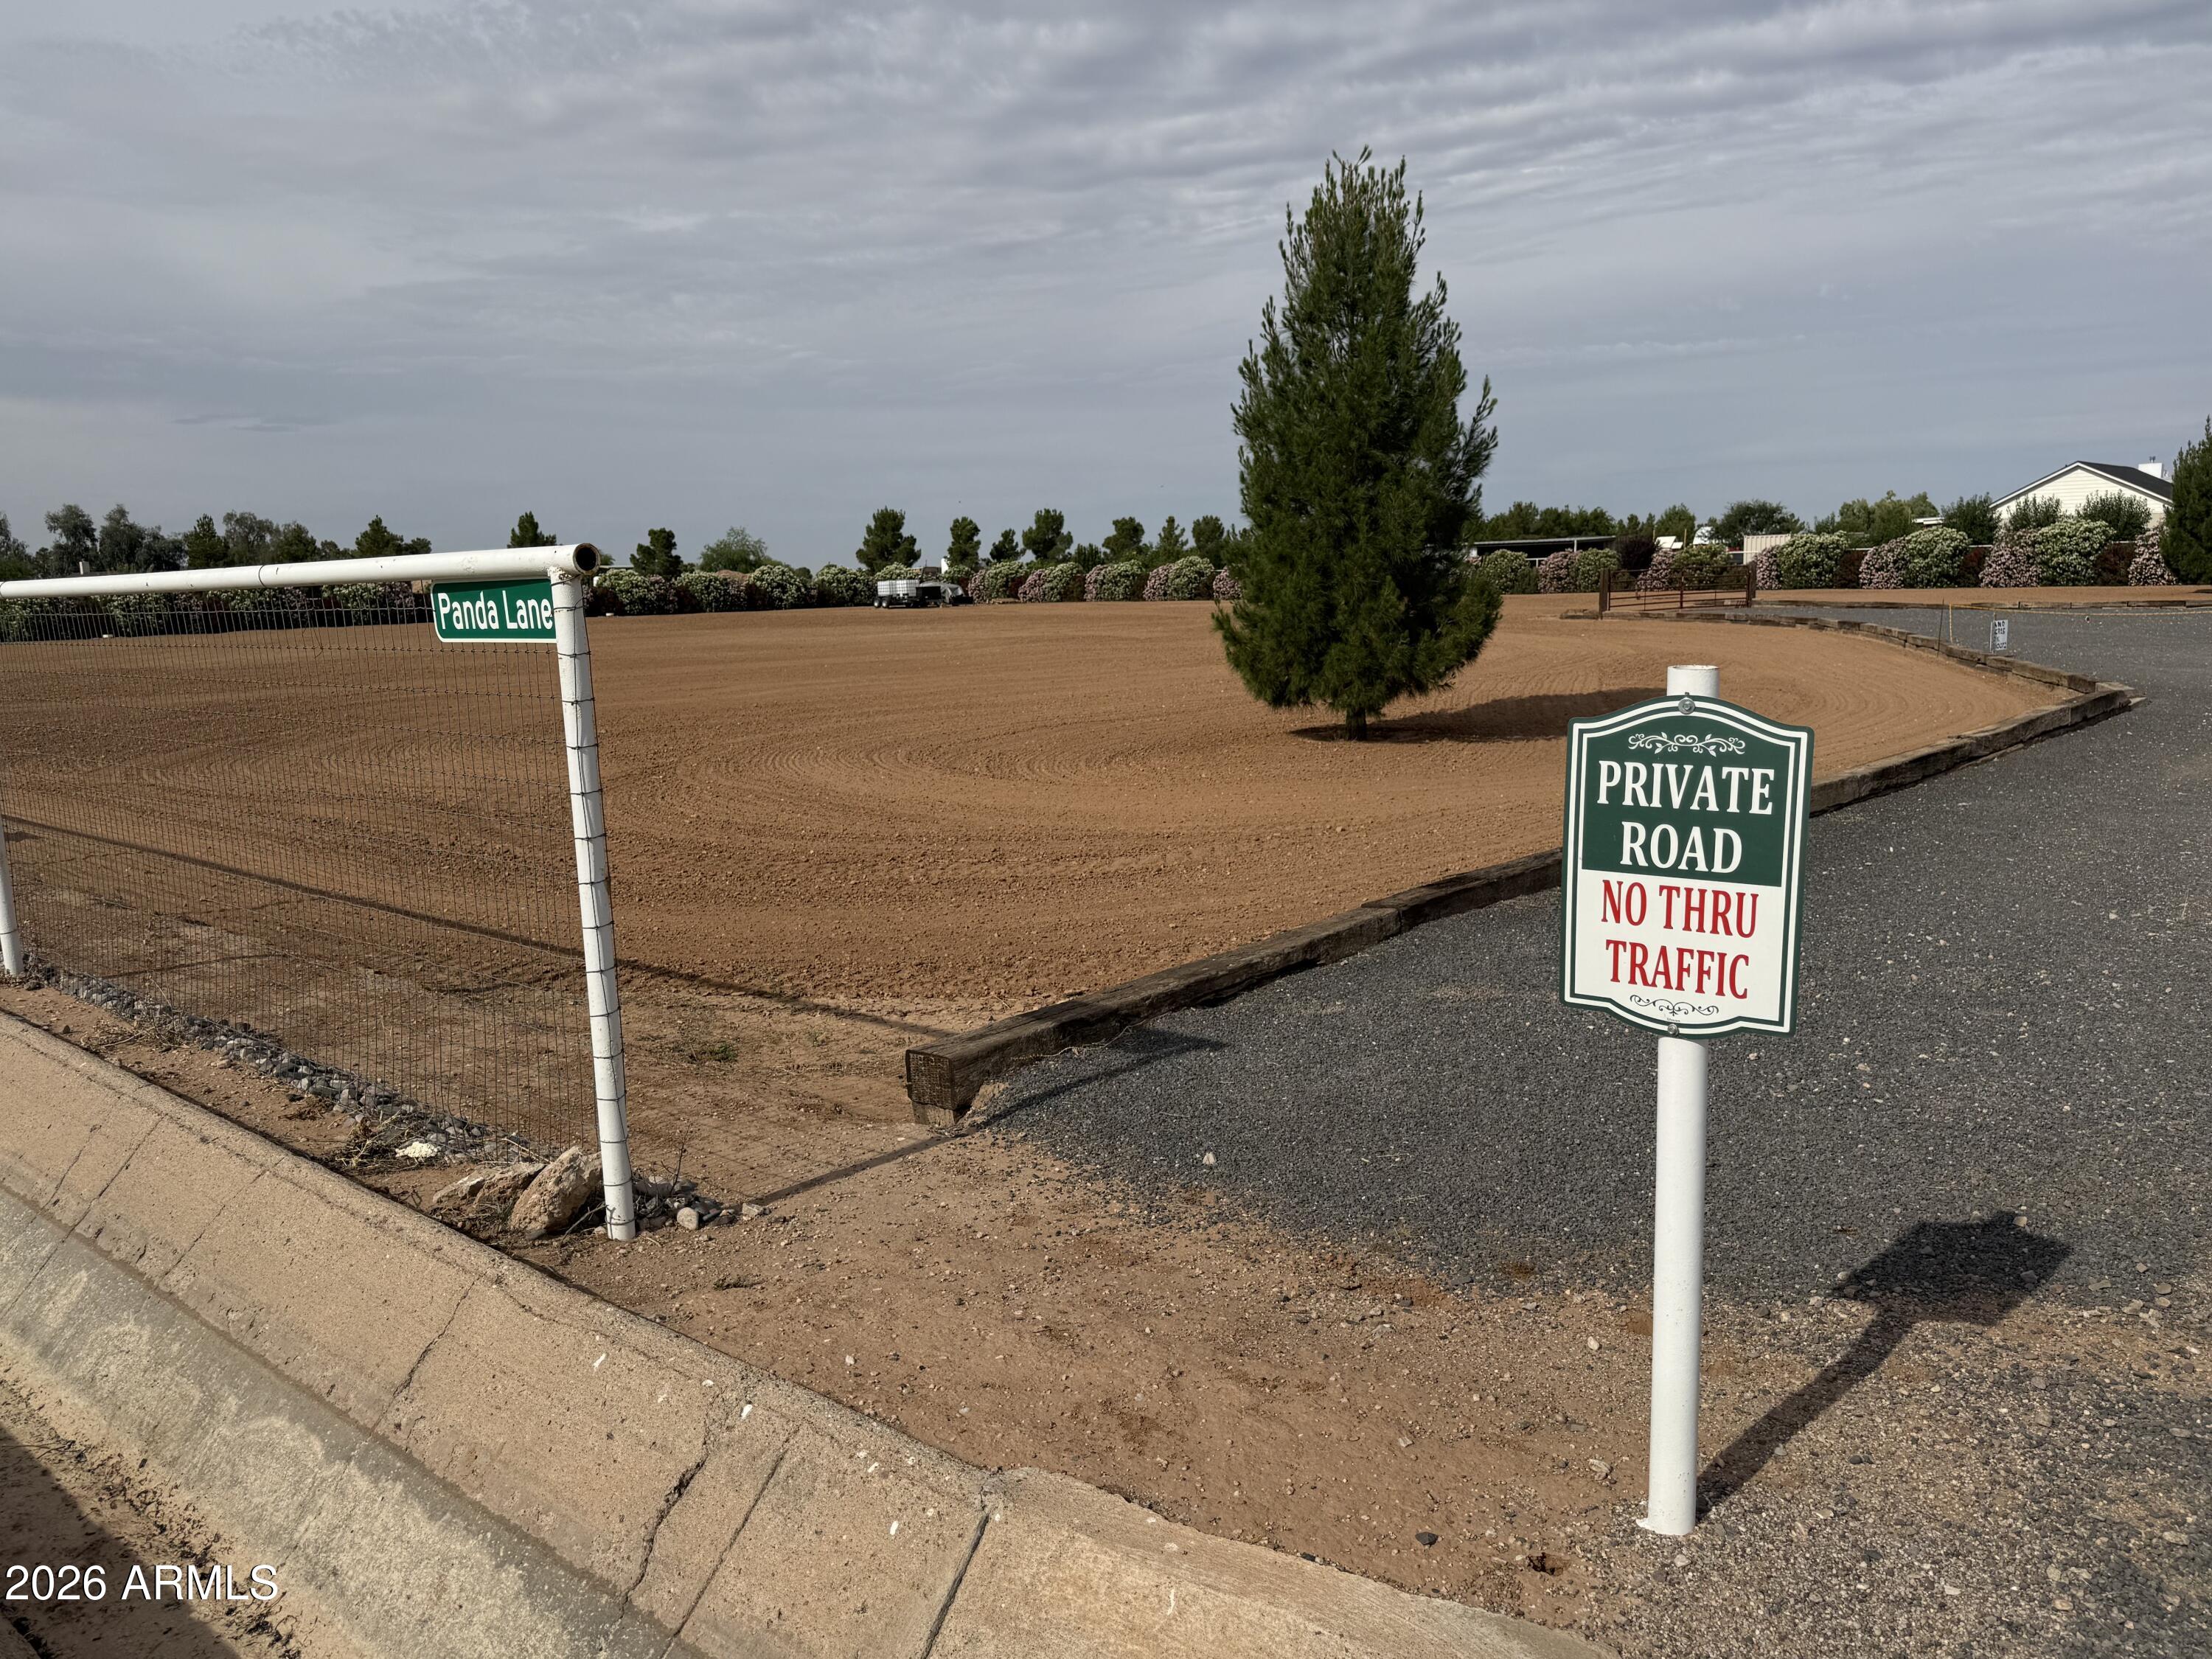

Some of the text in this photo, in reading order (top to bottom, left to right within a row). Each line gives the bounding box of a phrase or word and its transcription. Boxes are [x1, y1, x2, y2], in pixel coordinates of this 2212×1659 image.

[437, 590, 553, 630] Panda Lane
[1596, 760, 1775, 815] PRIVATE
[1620, 821, 1742, 874] ROAD
[1601, 879, 1759, 938] NO THRU
[1605, 939, 1749, 999] TRAFFIC
